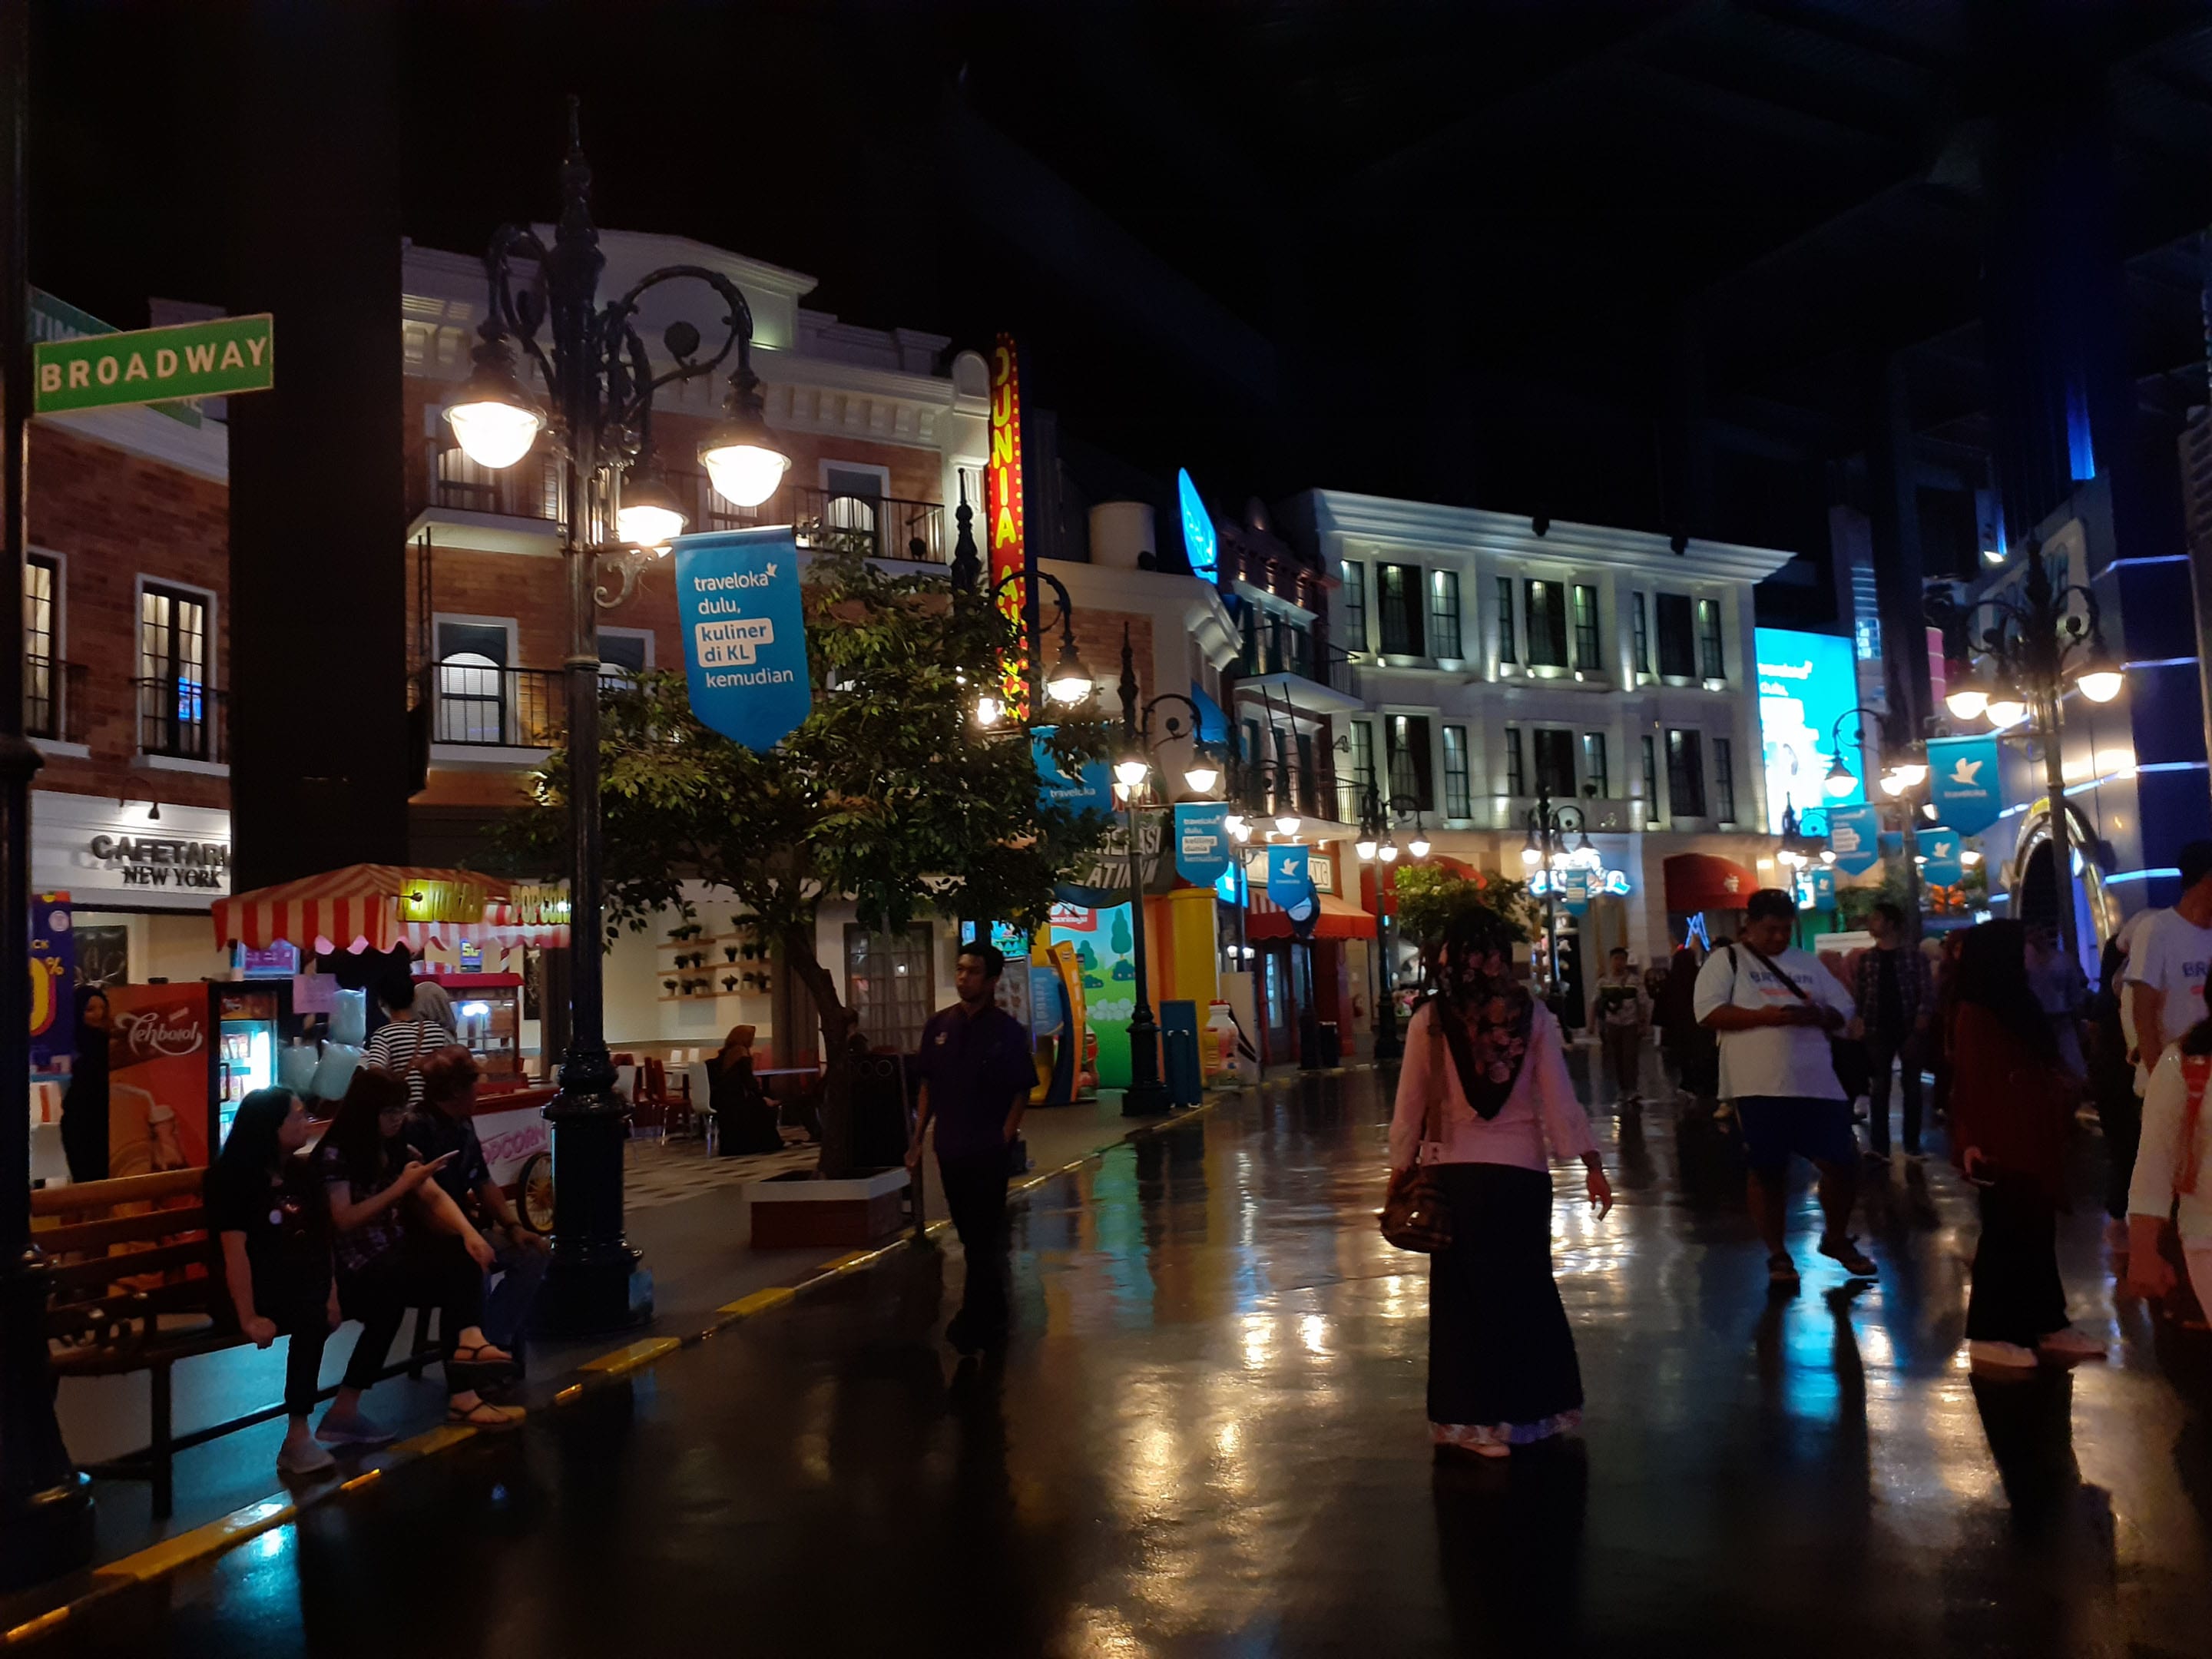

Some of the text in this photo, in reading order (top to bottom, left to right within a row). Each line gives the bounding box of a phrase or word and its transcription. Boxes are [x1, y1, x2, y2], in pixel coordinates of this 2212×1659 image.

[41, 336, 267, 393] BROADWAY
[993, 346, 1017, 549] DUNIA
[694, 570, 768, 592] traveloka
[698, 597, 741, 615] dulu,
[701, 624, 767, 642] kuliner
[704, 645, 750, 663] di KL
[705, 667, 794, 688] kemudian
[122, 866, 221, 889] NEW YORK
